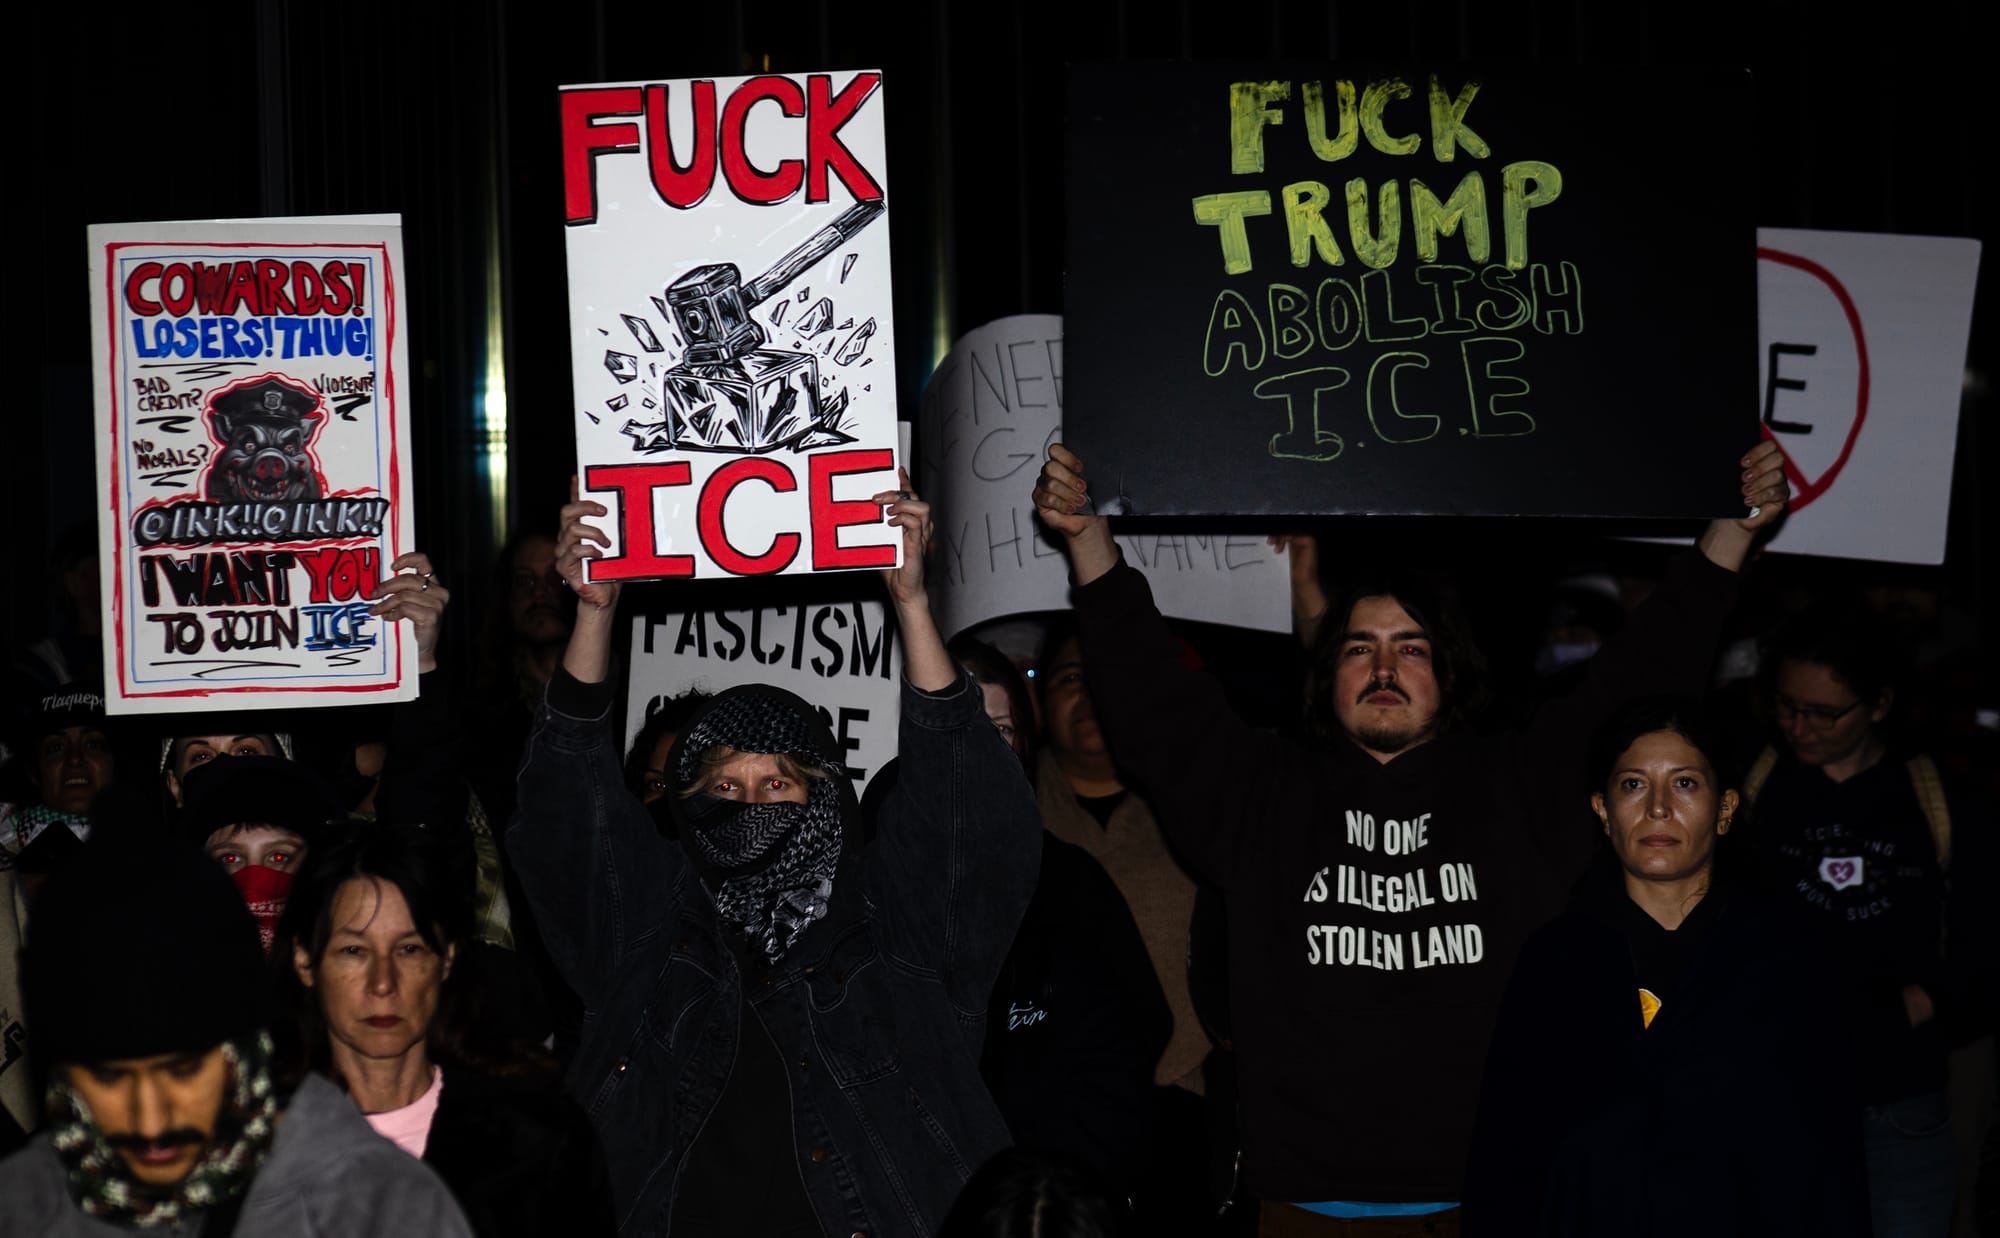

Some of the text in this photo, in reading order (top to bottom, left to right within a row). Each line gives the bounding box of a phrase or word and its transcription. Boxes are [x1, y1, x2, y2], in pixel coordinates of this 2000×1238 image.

[558, 73, 885, 227] FUCK
[1229, 73, 1491, 175] FUCK
[1192, 160, 1563, 275] TRUMP
[125, 259, 366, 318] COWARDS!
[1203, 260, 1584, 377] ABOLISH
[133, 377, 171, 396] BAD
[137, 388, 203, 413] CREDIT?
[132, 440, 154, 455] NO
[137, 447, 209, 470] MORALS?
[584, 448, 898, 584] ICE
[139, 548, 382, 607] I WANT YOU
[146, 602, 378, 654] TO JOIN ICE
[1345, 810, 1431, 855] NO ONE
[1337, 864, 1435, 913] ILLEGAL
[1439, 862, 1478, 903] ON
[1306, 924, 1483, 970] STOLEN LAND
